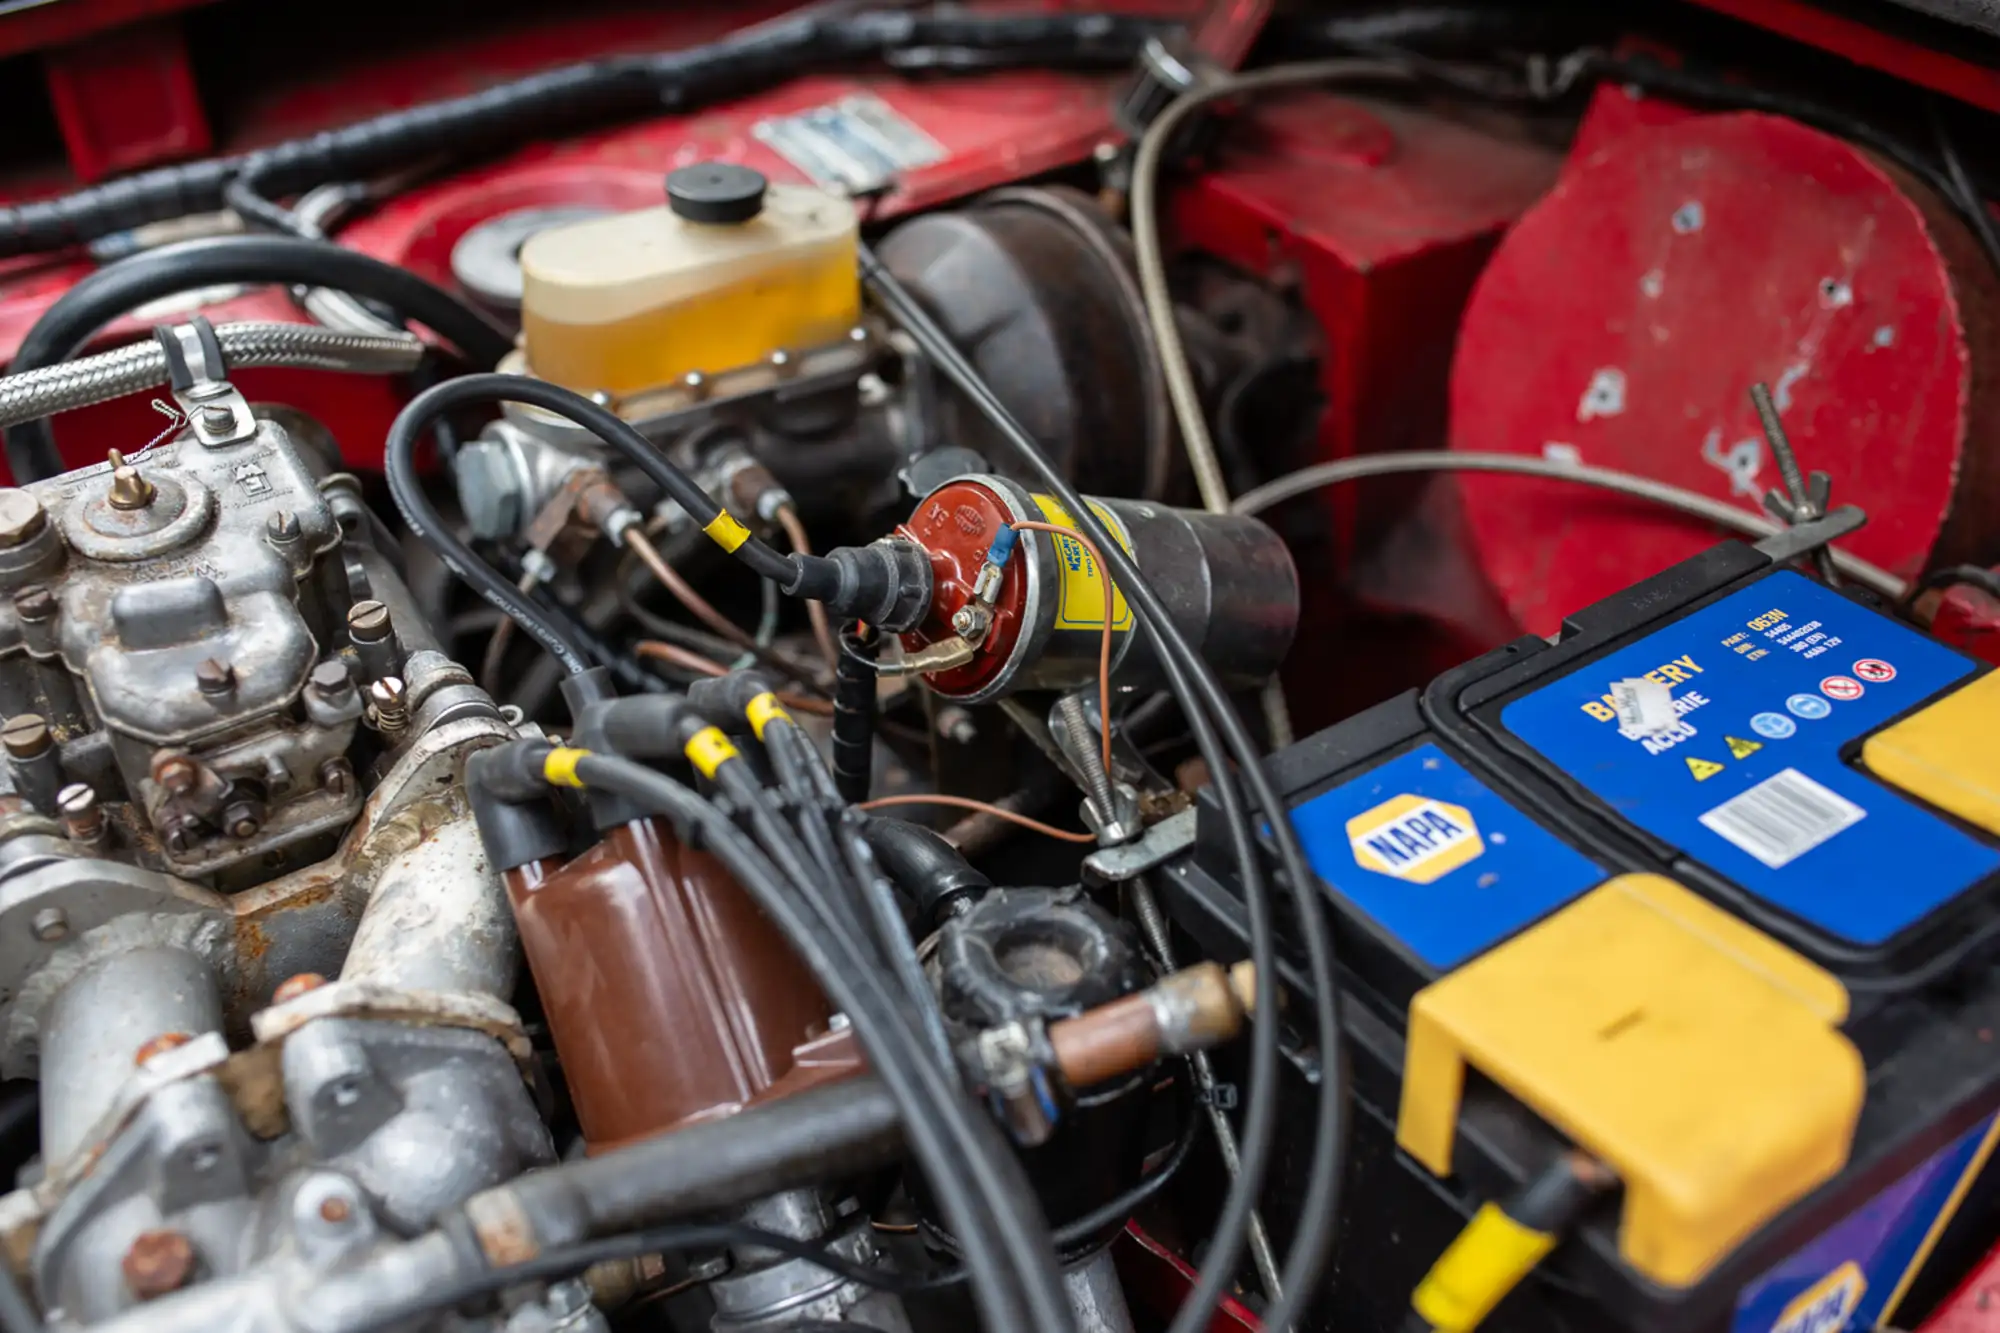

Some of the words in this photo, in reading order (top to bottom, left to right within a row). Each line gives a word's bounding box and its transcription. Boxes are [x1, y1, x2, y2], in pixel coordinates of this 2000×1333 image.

[1720, 631, 1750, 647] PART:
[1746, 608, 1789, 632] 063N
[1580, 654, 1705, 723] BAERY
[1367, 809, 1463, 866] NAPA
